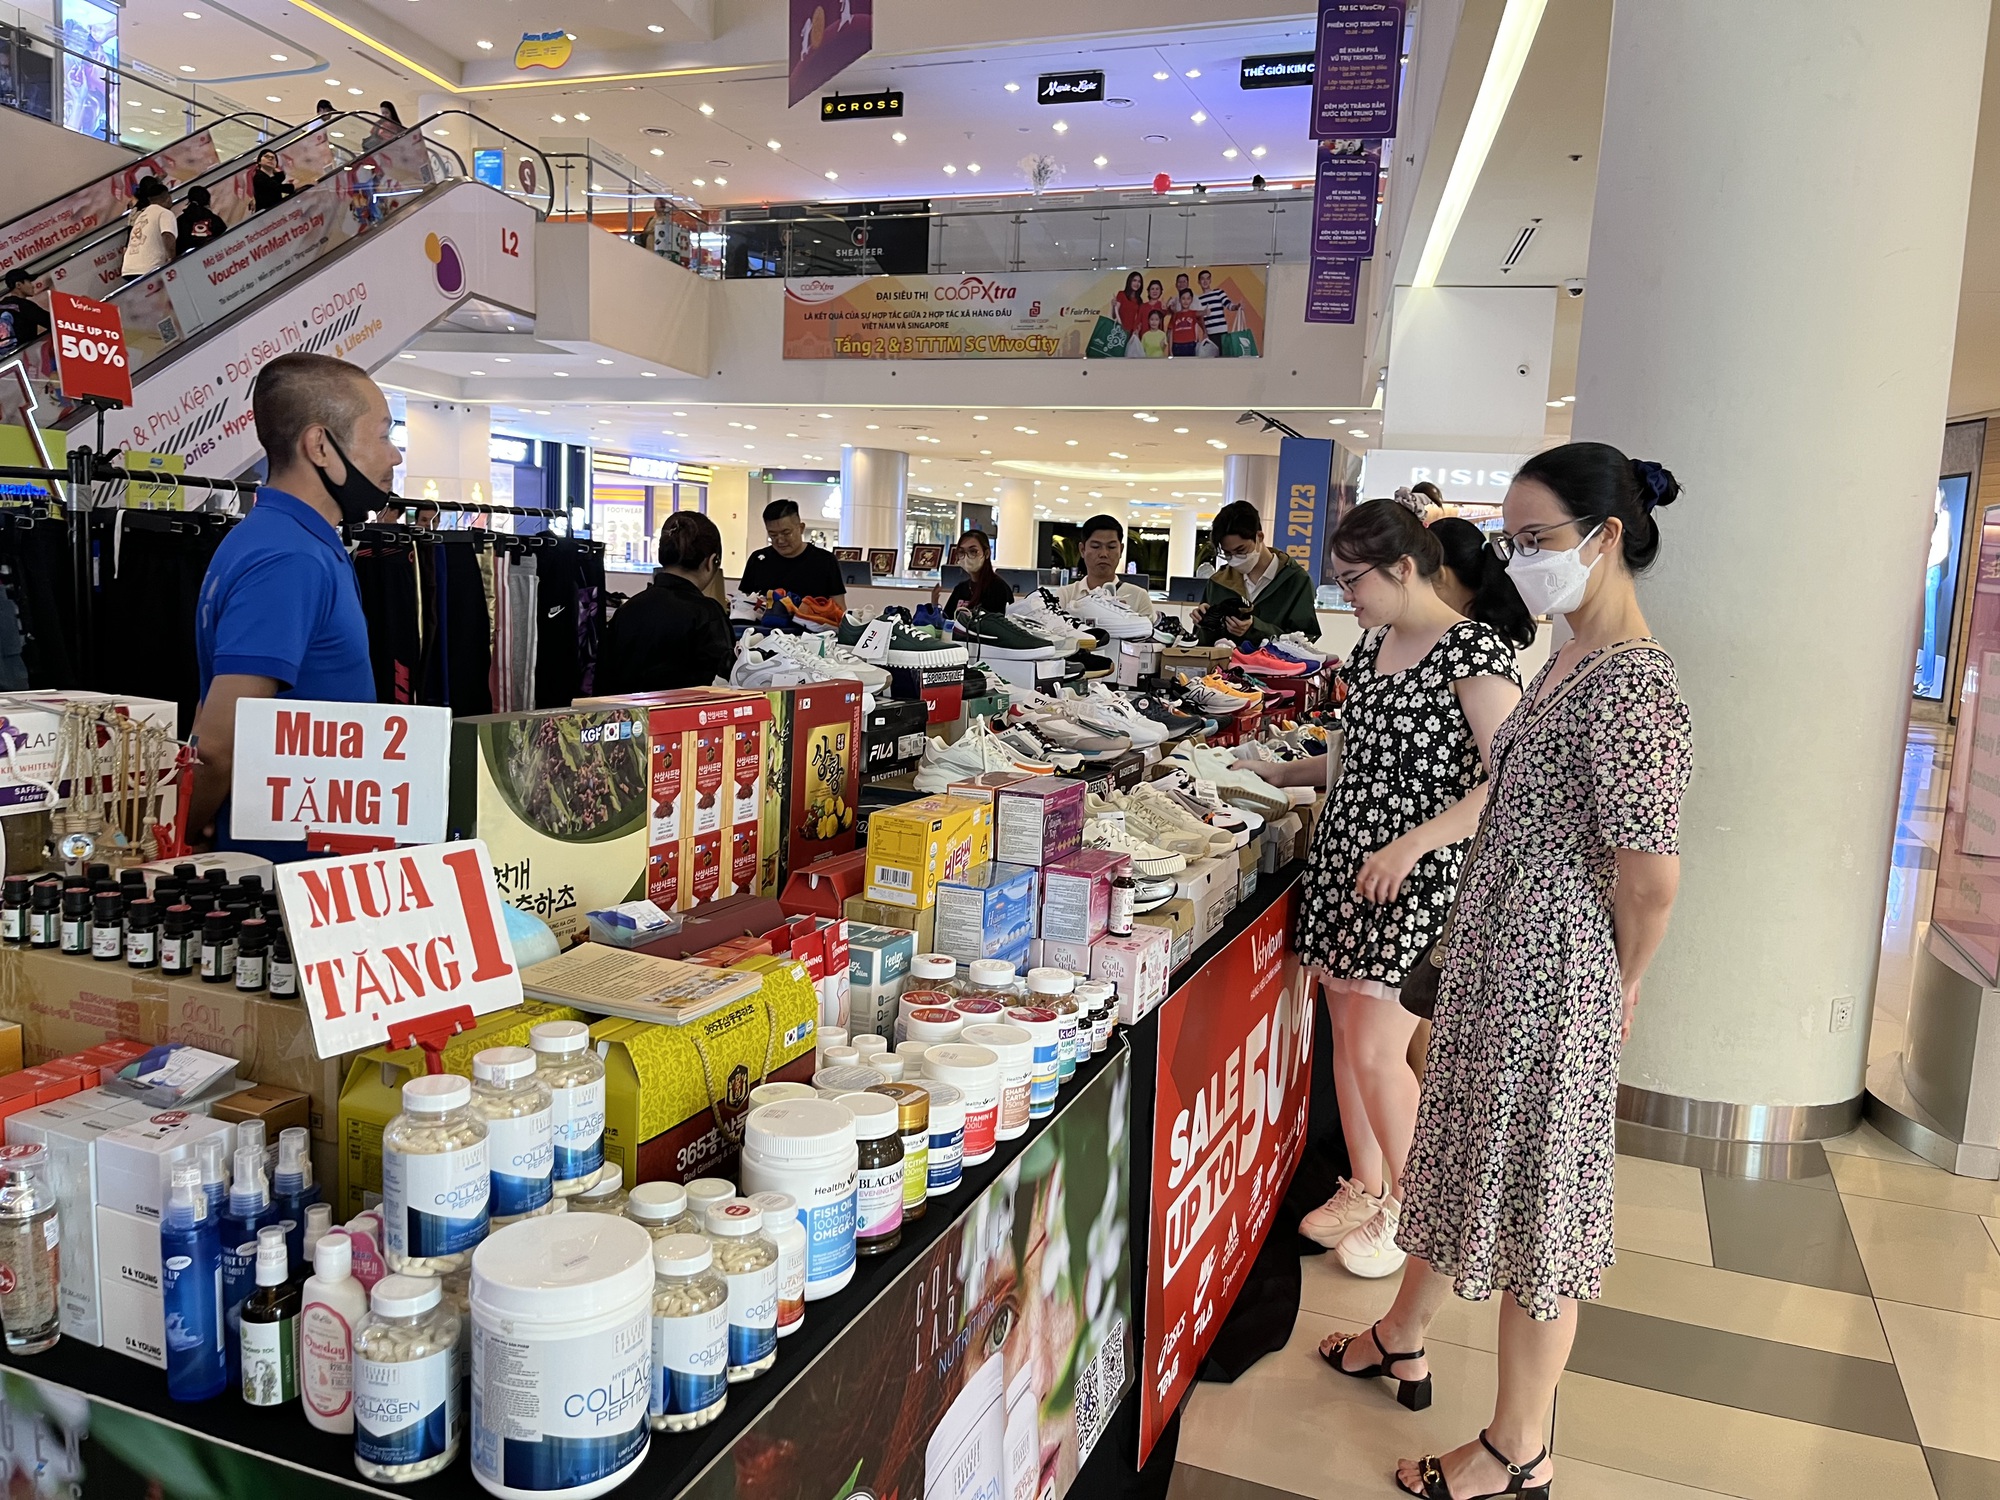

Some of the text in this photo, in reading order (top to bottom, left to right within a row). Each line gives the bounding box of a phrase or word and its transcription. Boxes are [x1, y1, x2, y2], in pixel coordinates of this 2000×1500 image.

[1243, 64, 1306, 77] THẾ GIỚI KIM
[837, 99, 899, 112] CROSS
[13, 213, 98, 262] WinMart trao tay
[214, 251, 225, 264] tài
[244, 214, 289, 245] Techcombank
[502, 227, 519, 258] L2
[207, 212, 325, 286] Voucher WinMart trao tay
[836, 248, 883, 257] SHEAFFER
[876, 290, 929, 301] ĐẠI SIÊU THỊ
[804, 309, 1012, 321] LÀ KẾT QUẢ CỦA SỰ HỢP TÁC GIỮA 2 HỢP TÁC XÃ HÀNG ĐẦU
[1070, 307, 1101, 317] FairPrice
[57, 319, 120, 341] SALE UP TO
[862, 321, 949, 330] VIỆT NAM VÀ SINGAPORE
[335, 316, 384, 360] & Lifestyle
[834, 334, 1060, 356] Tầng 2 & 3 TTTM SC VivoCity
[61, 334, 126, 368] 50%
[132, 426, 149, 447] &
[147, 408, 180, 437] Phụ
[178, 381, 215, 416] Kiện
[225, 355, 252, 383] Đại
[251, 337, 282, 367] Siêu
[279, 321, 301, 347] Thị
[1411, 466, 1513, 486] RISIS
[862, 630, 877, 649] FILA
[275, 710, 408, 761] Mua 2
[736, 754, 759, 767] 산삼사프란
[869, 741, 894, 762] FILA
[653, 769, 681, 783] 산삼사프란
[698, 761, 722, 775] 산삼사프란
[1119, 762, 1140, 779] BASKETBALL
[266, 777, 410, 831] TẶNG 1
[297, 856, 434, 929] MUA
[442, 848, 514, 983] 1
[1101, 960, 1125, 973] Colla
[304, 935, 462, 1021] TẶNG
[182, 995, 225, 1035] Top
[1060, 1029, 1076, 1039] Kids
[1237, 965, 1314, 1177] 50%
[1005, 1087, 1025, 1096] SHARK
[1005, 1100, 1024, 1109] 750mg
[1167, 1046, 1240, 1190] SALE
[683, 1166, 696, 1184] Red
[697, 1153, 723, 1177] Ginseng
[434, 1174, 490, 1206] COLLAGE
[814, 1180, 847, 1196] Healthy
[859, 1185, 890, 1197] EVENING
[813, 1198, 853, 1220] FISH OIL
[1168, 1140, 1234, 1269] UP TO
[813, 1211, 852, 1231] 1000mg
[813, 1215, 855, 1241] OMEGA-3
[1221, 1234, 1239, 1269] adidas
[128, 1268, 134, 1277] &
[133, 1269, 158, 1285] YOUNG
[1193, 1299, 1214, 1346] FILA
[131, 1338, 137, 1348] &
[137, 1340, 162, 1356] YOUNG
[305, 1335, 345, 1360] Oneday
[938, 1295, 996, 1379] NUTRITION
[564, 1356, 651, 1418] COLLAG
